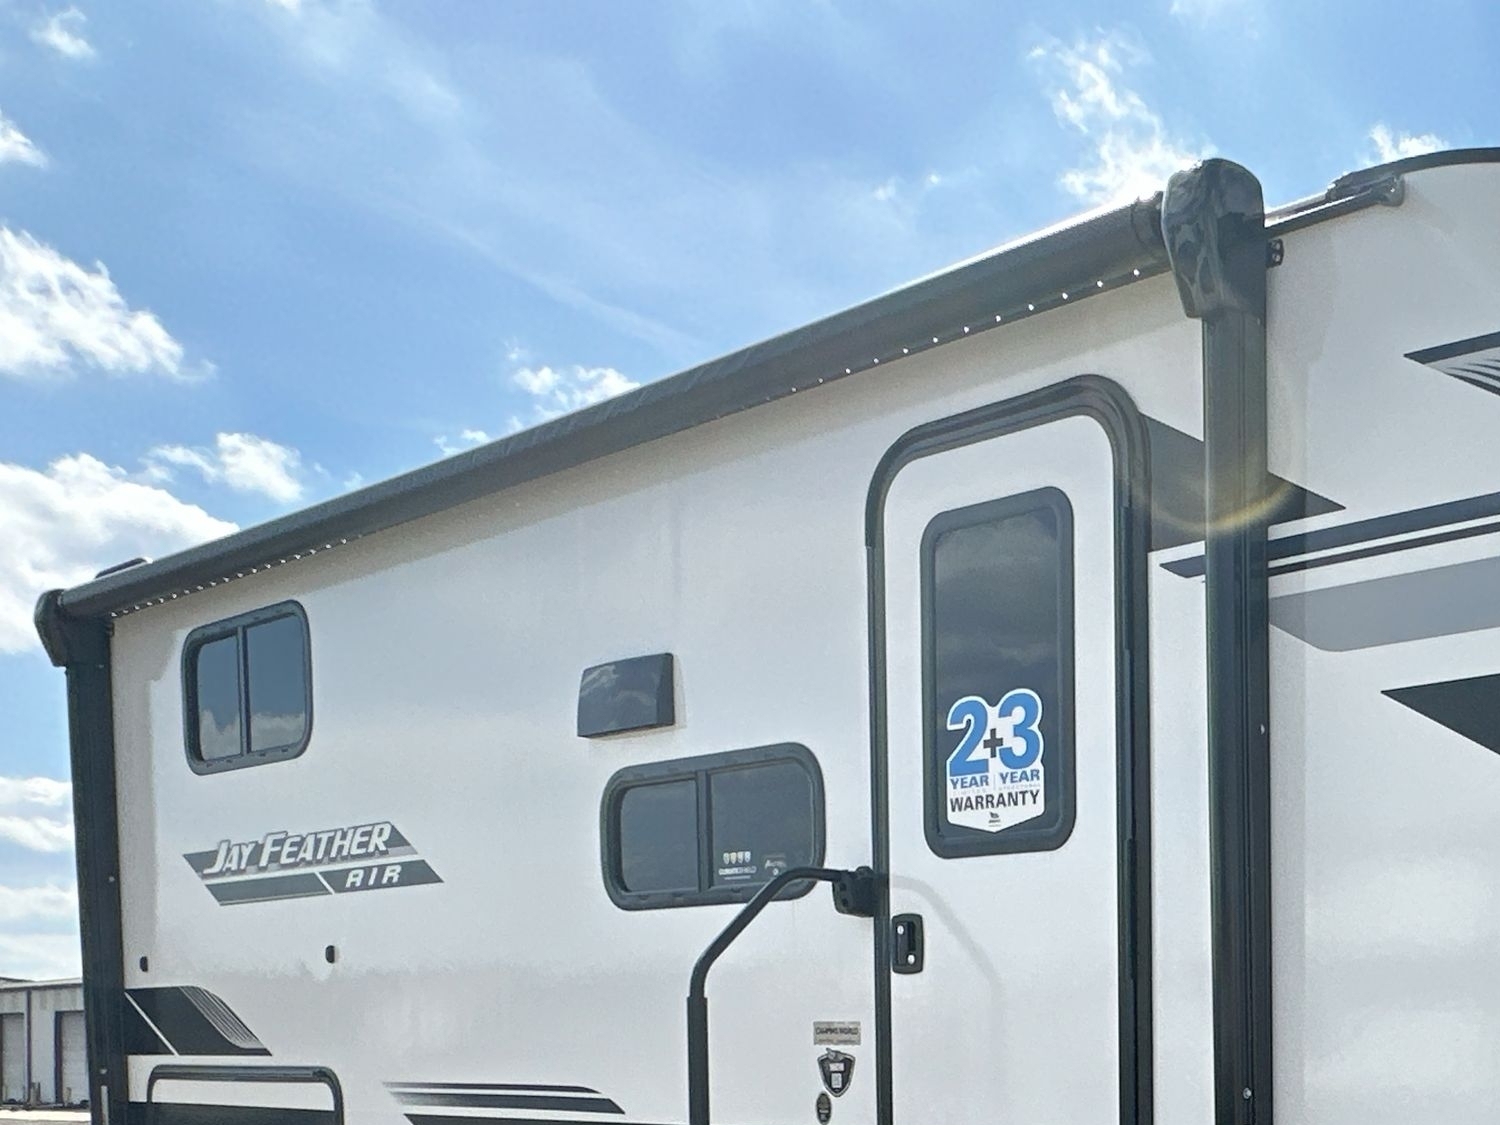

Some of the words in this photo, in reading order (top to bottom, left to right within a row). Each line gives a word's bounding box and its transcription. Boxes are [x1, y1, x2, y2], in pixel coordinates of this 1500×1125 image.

[950, 775, 990, 790] YEAR
[999, 769, 1041, 784] YEAR
[950, 789, 1041, 813] WARRANTY
[202, 840, 257, 875] JAY
[258, 822, 393, 867] FEATHER
[345, 865, 402, 888] AIR
